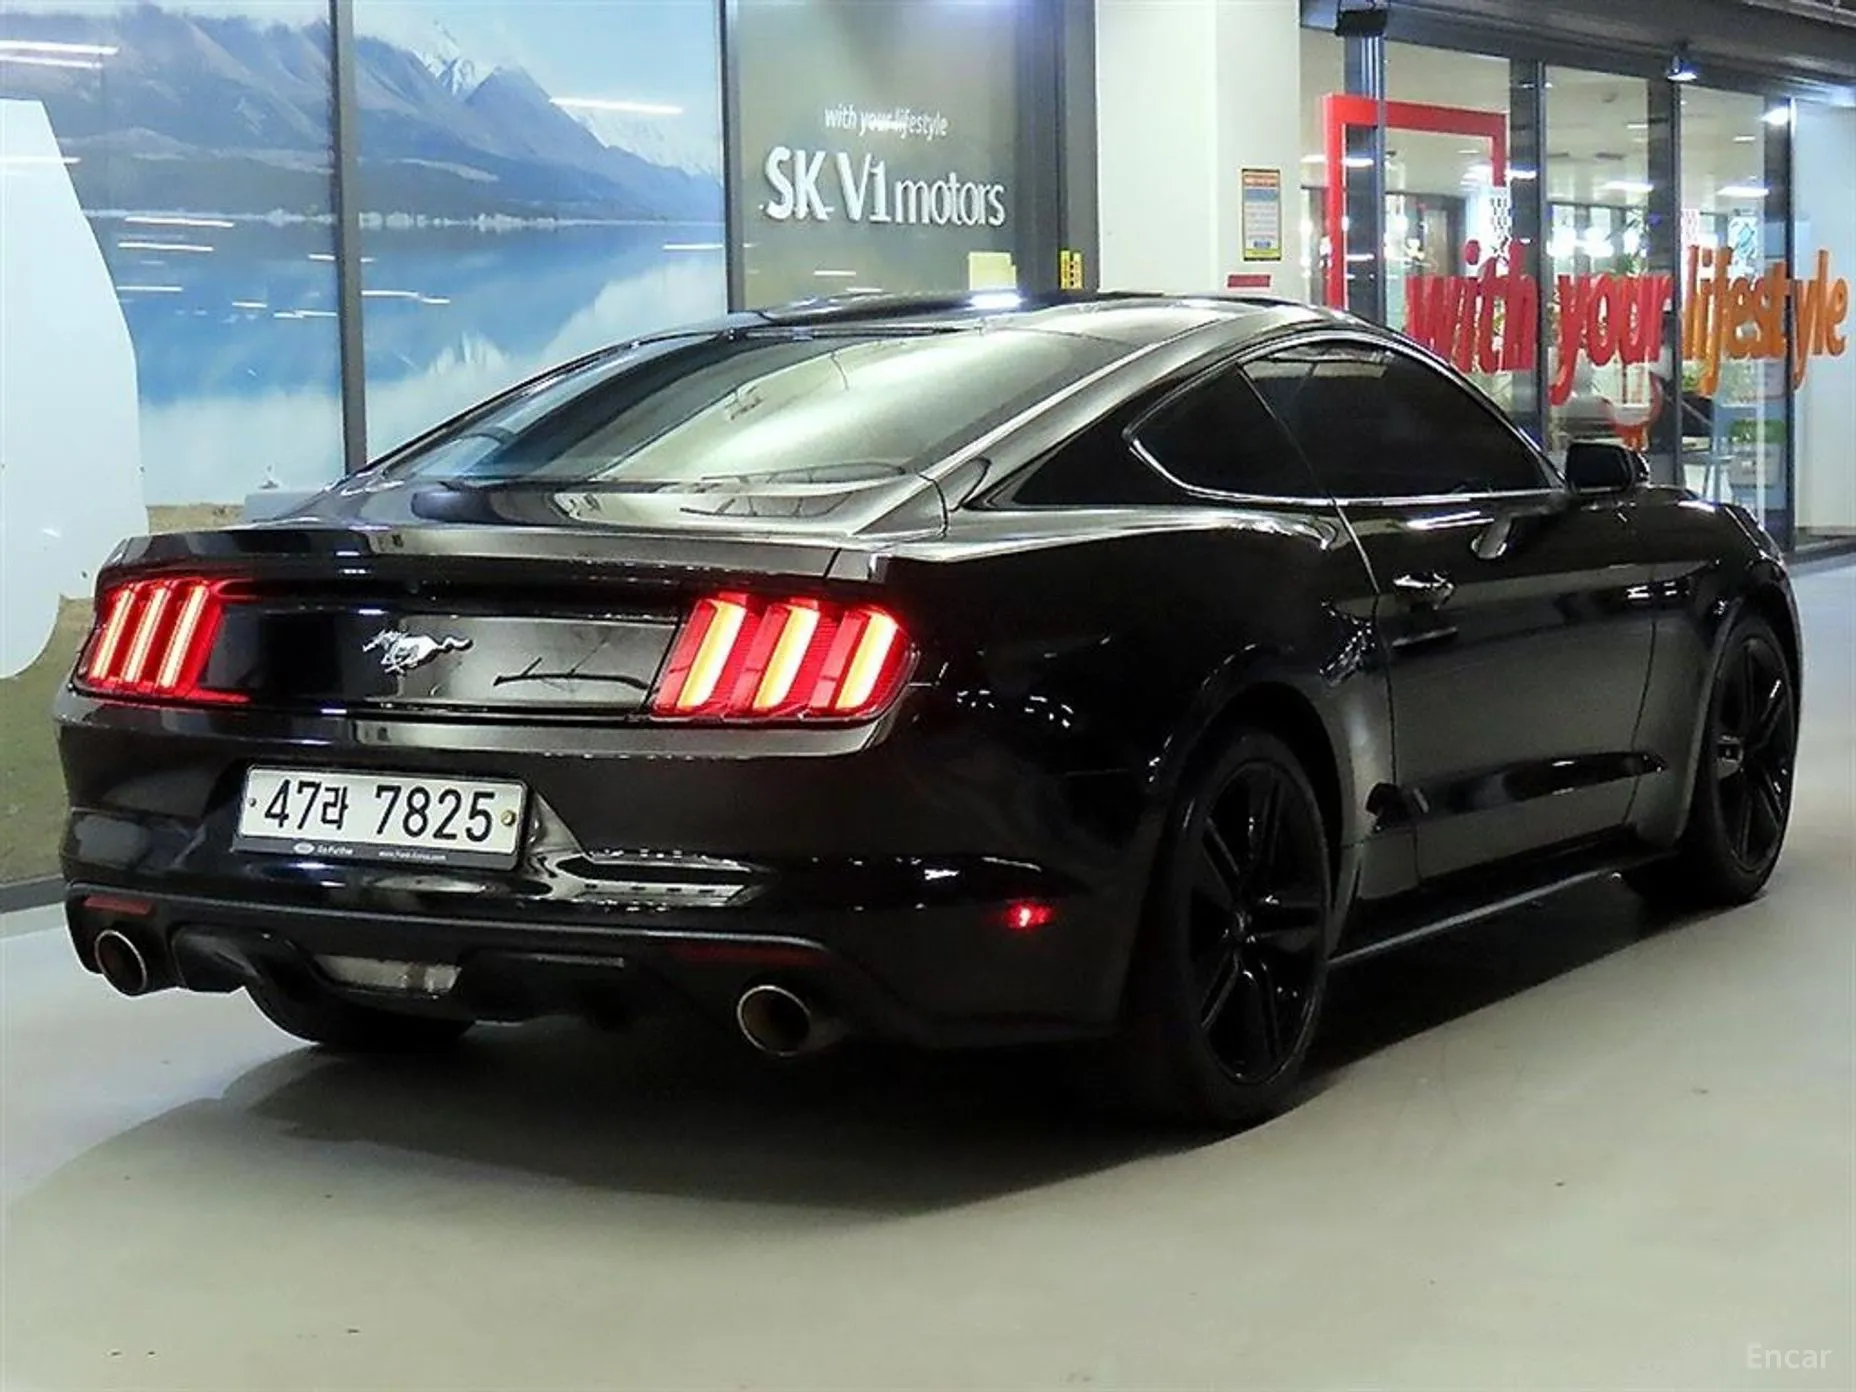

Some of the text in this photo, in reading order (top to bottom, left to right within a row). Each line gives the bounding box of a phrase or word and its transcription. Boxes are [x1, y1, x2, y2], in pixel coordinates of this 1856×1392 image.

[824, 103, 948, 140] with your lifestyle
[765, 146, 829, 220] SK
[895, 171, 1006, 226] motors
[1404, 239, 1848, 405] with your lifestyle
[264, 779, 496, 842] 47라 7825
